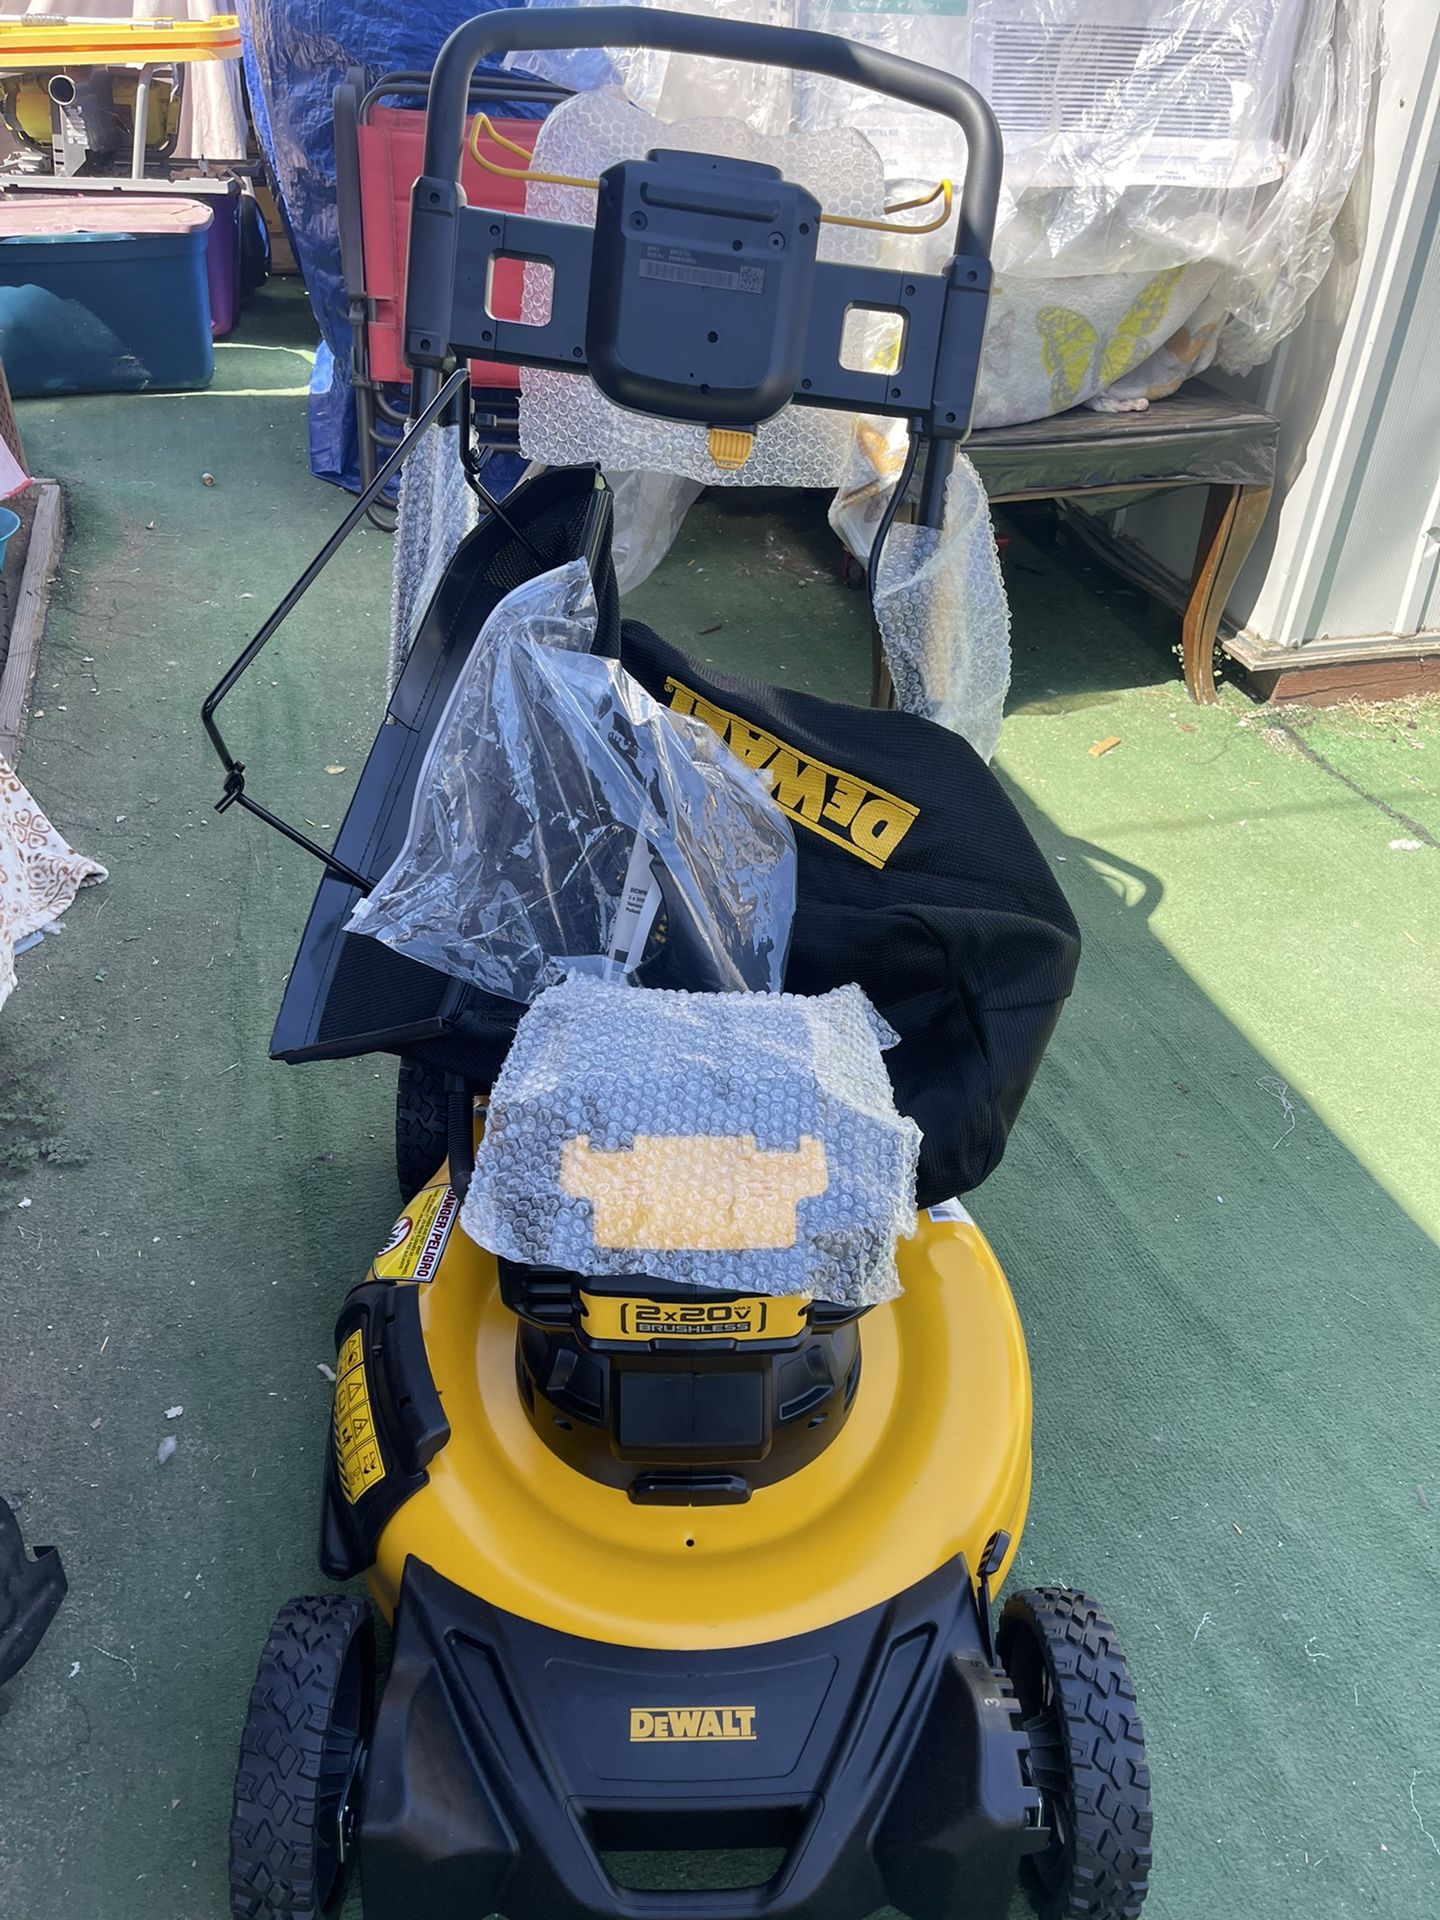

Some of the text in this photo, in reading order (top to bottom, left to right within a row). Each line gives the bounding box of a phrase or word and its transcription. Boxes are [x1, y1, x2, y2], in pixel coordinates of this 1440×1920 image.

[638, 1322, 749, 1333] BRUSHLESS
[984, 1697, 1001, 1707] 3
[630, 1709, 756, 1738] DEWALT
